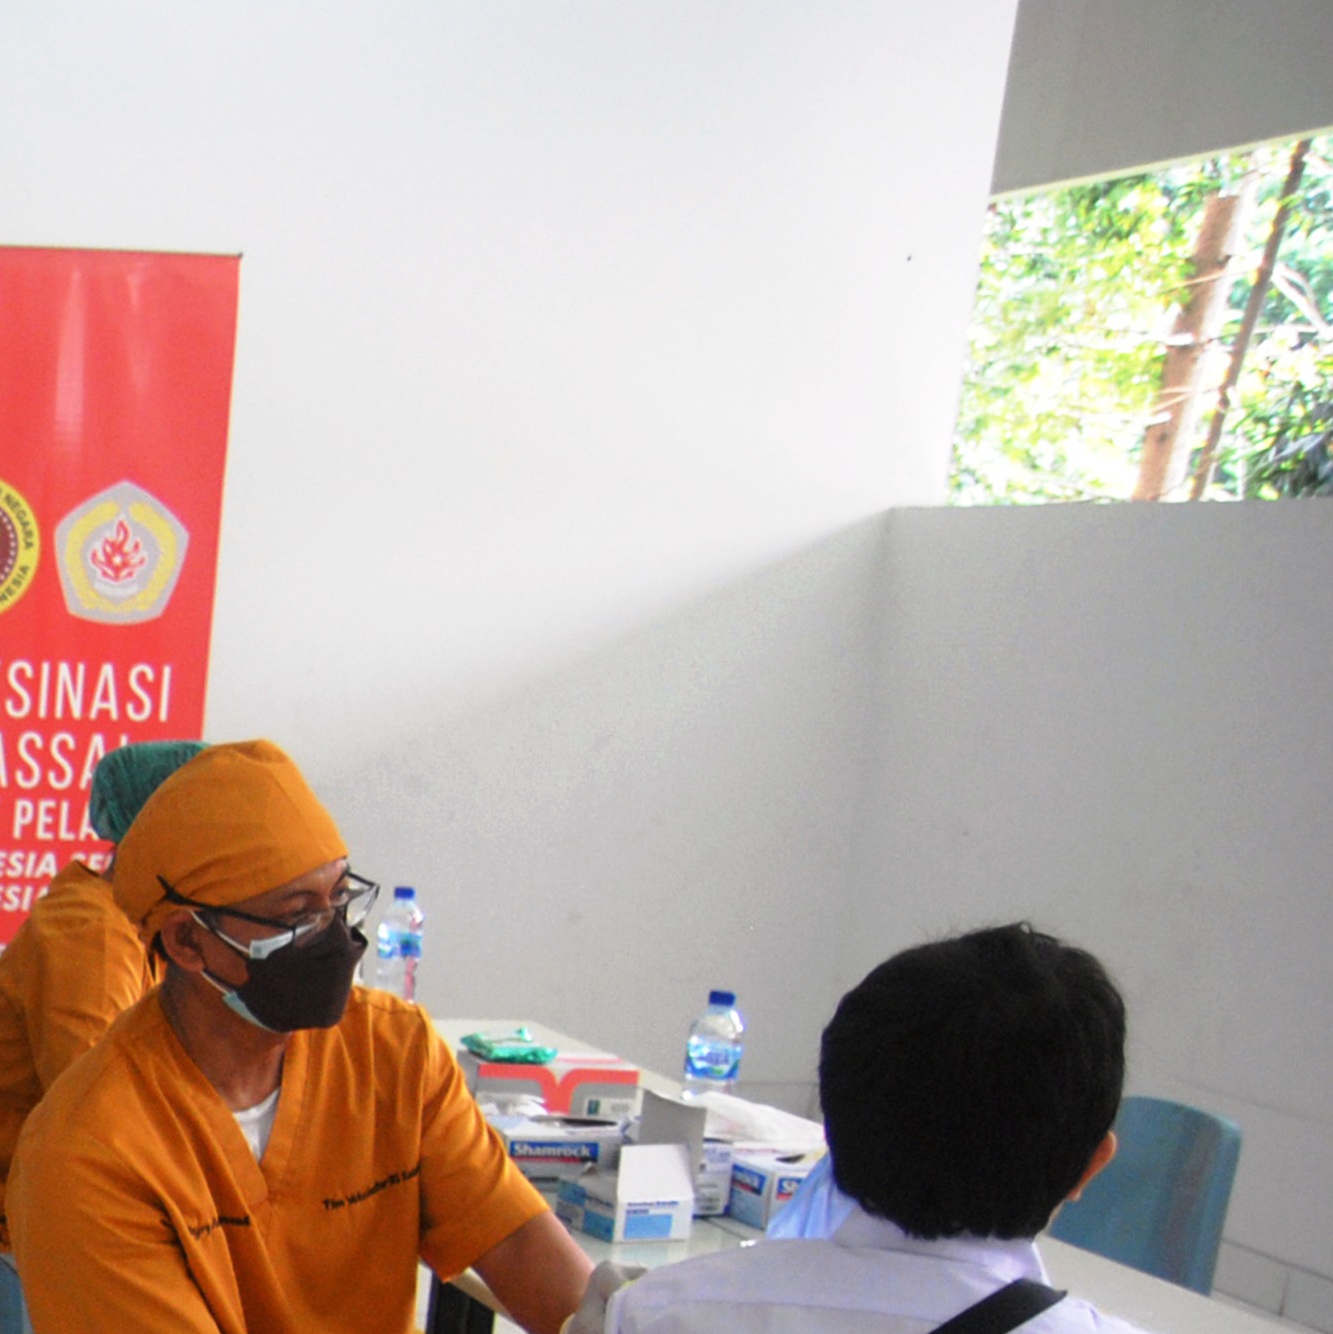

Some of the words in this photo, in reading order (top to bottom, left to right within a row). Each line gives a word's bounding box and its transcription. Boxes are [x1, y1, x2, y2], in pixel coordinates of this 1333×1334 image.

[4, 493, 34, 549] NEGARA
[12, 799, 99, 841] PELA
[513, 1142, 591, 1158] Shamrock
